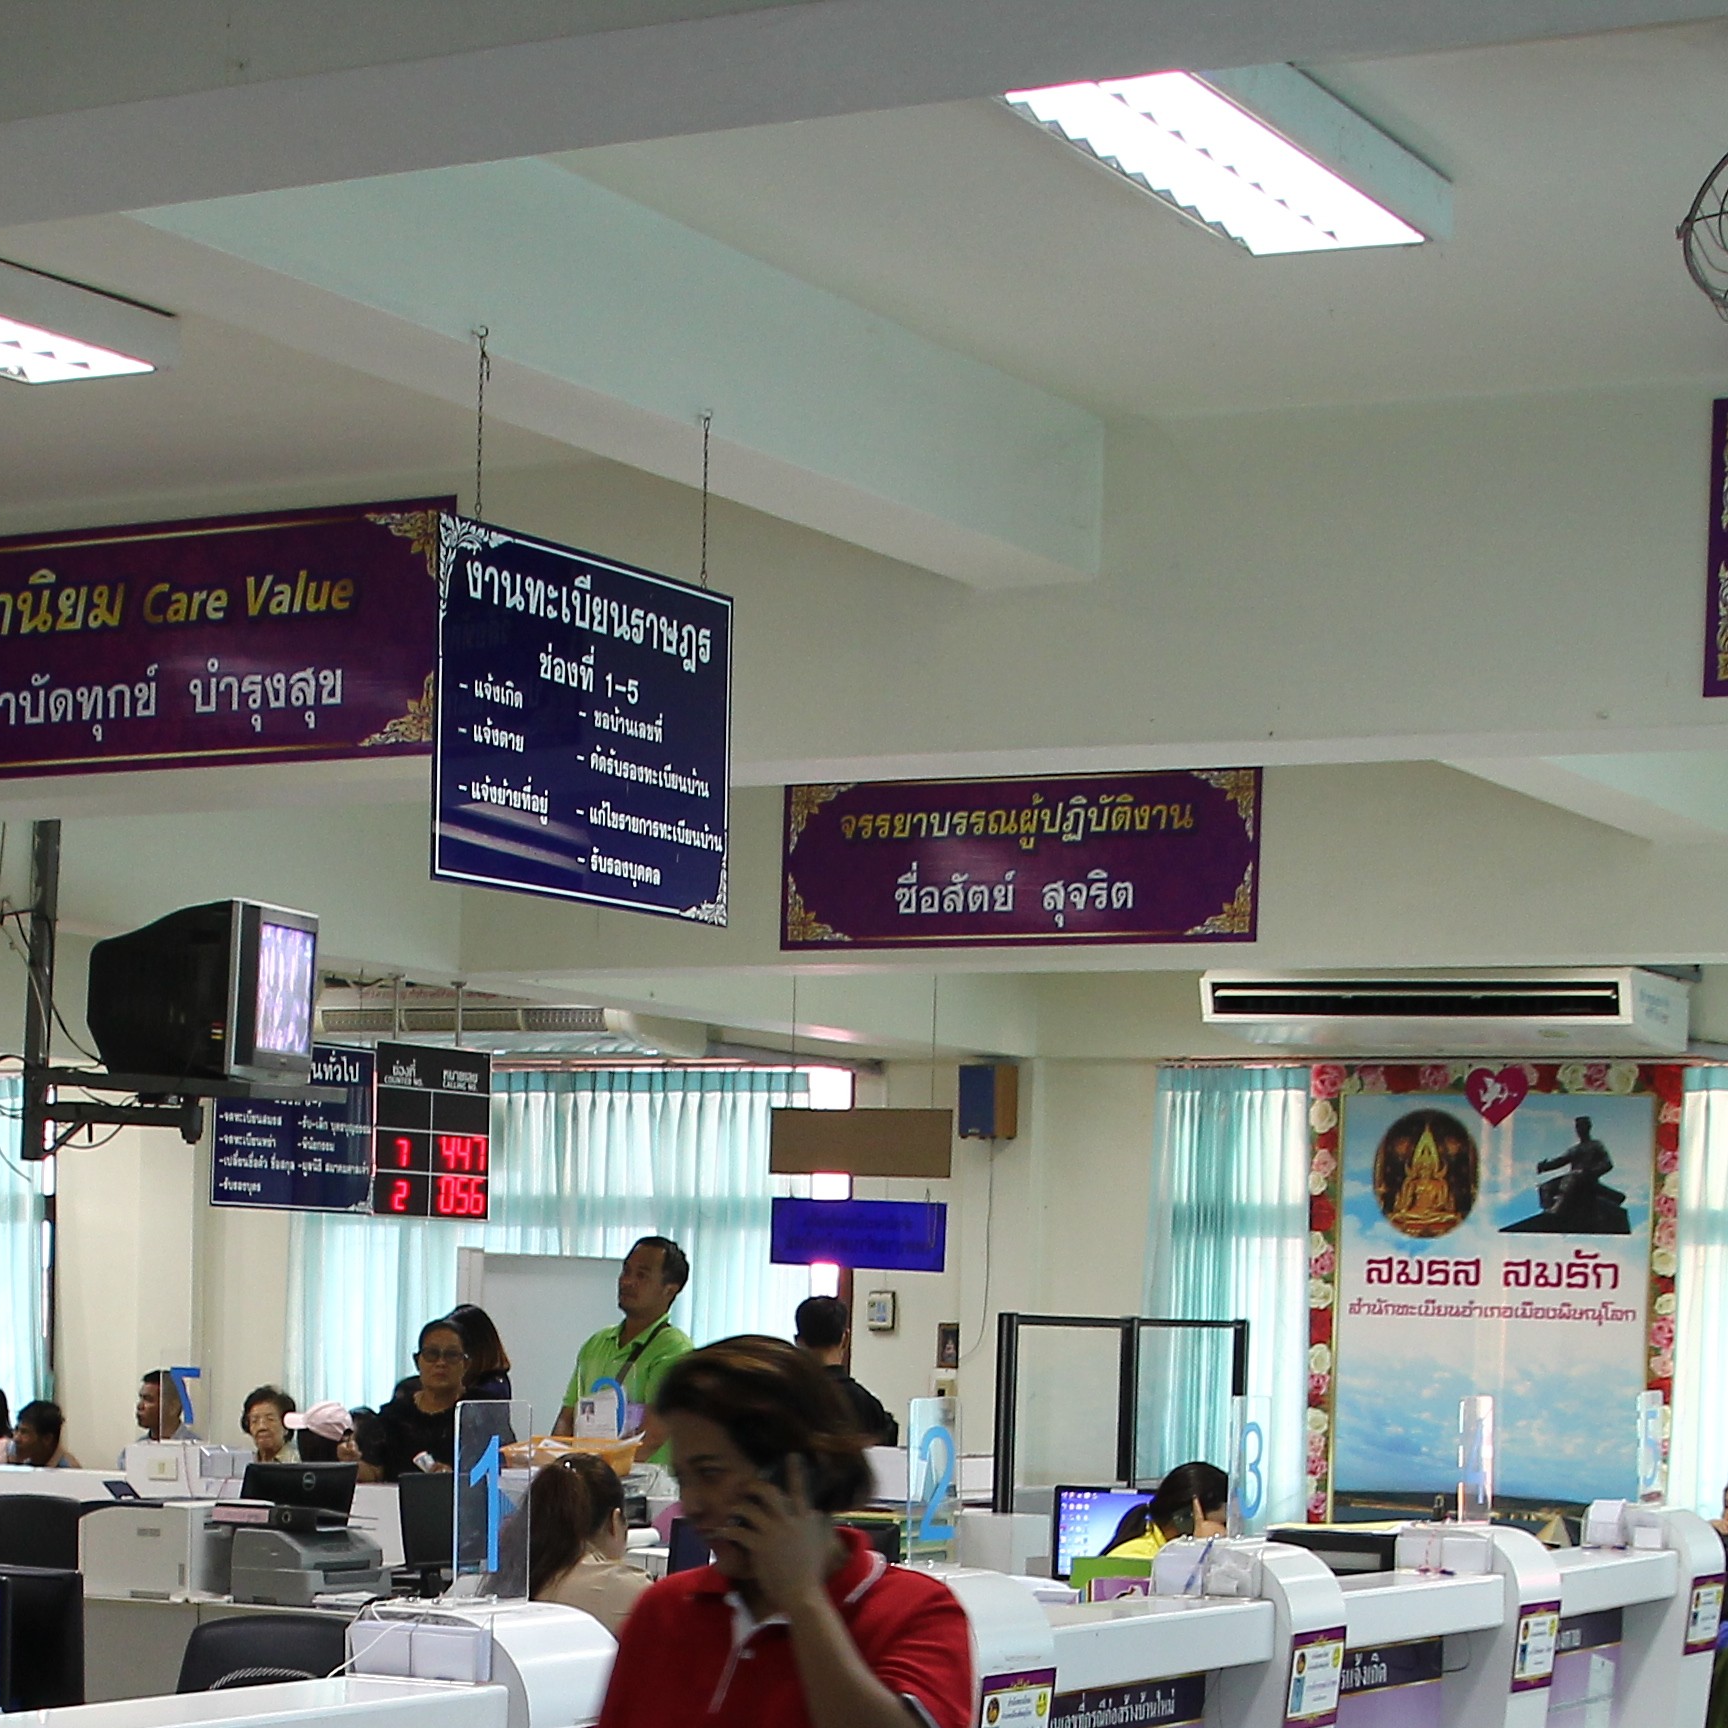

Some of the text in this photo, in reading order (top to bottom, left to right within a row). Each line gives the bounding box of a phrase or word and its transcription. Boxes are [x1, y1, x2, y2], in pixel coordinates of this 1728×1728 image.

[143, 581, 228, 625] Care
[246, 573, 354, 620] Value
[466, 559, 712, 674] งานทะเบียนราษฎร
[189, 660, 343, 735] บำรุงสุข
[474, 675, 524, 709] แจ้งเกิด
[539, 643, 640, 705] ช่องที่ 1-5
[473, 717, 525, 753] แจ้งตาย
[593, 703, 665, 744] ขอบ้านเลขที่
[471, 774, 549, 825] แจ้งย้ายที่อยู่
[590, 748, 711, 799] คัดรับรองทะเบียนบ้าน
[589, 800, 724, 854] แก้ไขรายการทะเบียนบ้าน
[841, 791, 1194, 849] จรรยาบรรณผู้ปฏิบัติงาน
[590, 849, 661, 888] รับรองบุคคล
[894, 861, 1134, 928] ซื่อสัตย์ สุจริต
[395, 1136, 486, 1171] 7 447
[393, 1177, 485, 1215] 2 056
[1366, 1249, 1619, 1290] สมรส สมรัก
[919, 1426, 954, 1540] 2
[1238, 1421, 1263, 1519] 3
[470, 1435, 500, 1573] 1
